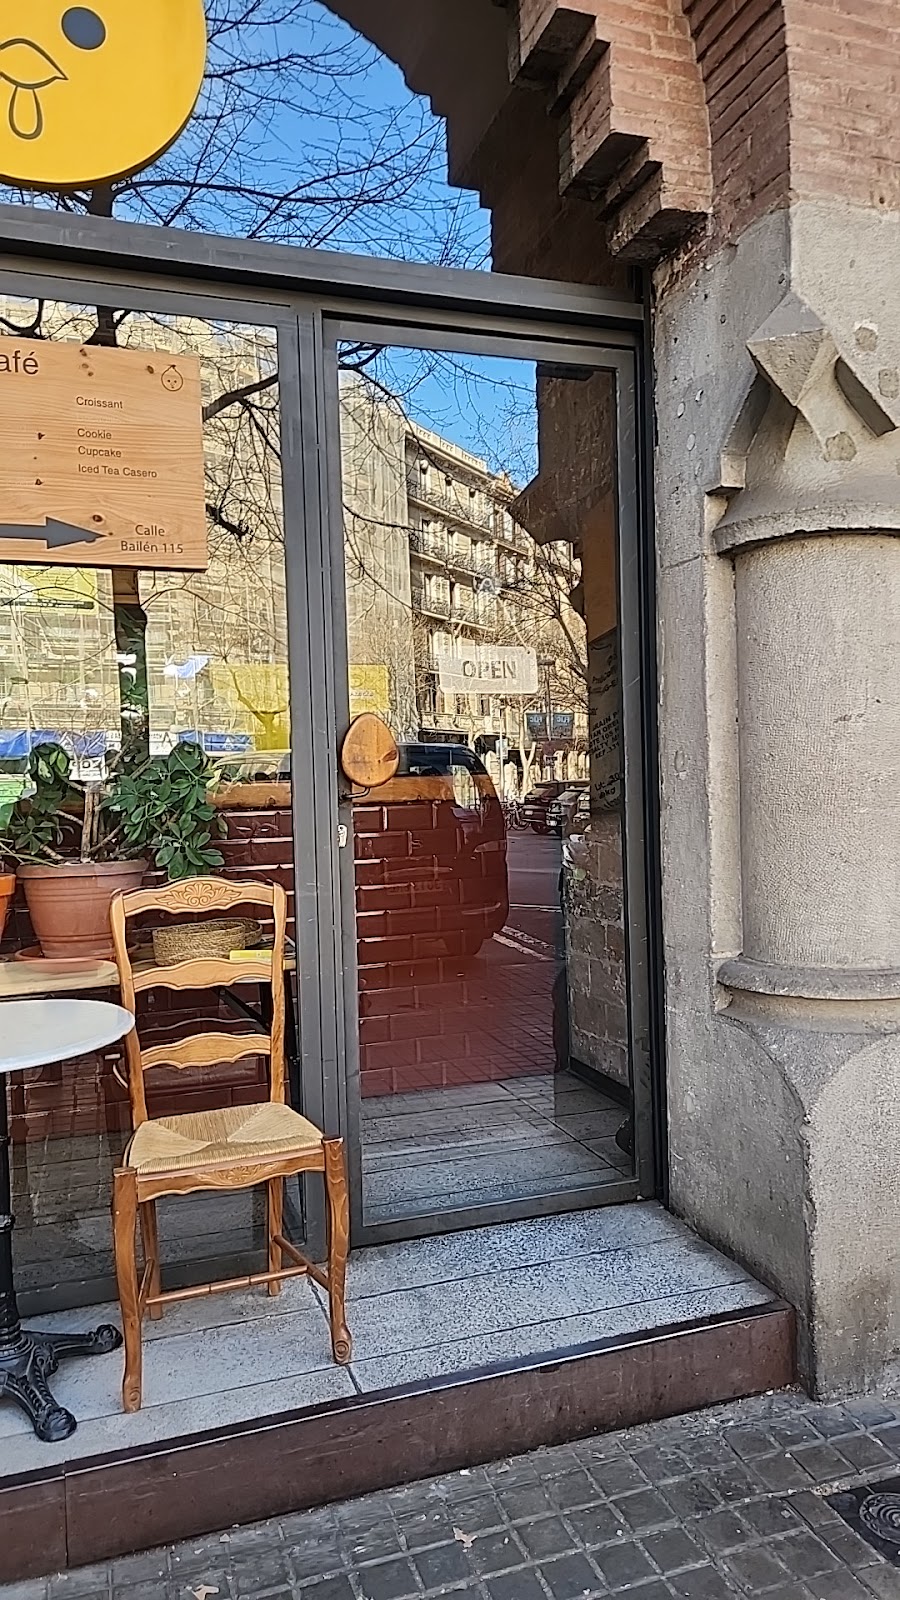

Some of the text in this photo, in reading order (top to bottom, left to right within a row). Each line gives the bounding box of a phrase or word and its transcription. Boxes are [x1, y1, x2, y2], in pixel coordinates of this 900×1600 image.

[76, 396, 123, 409] Croissant
[77, 428, 112, 440] Cookie
[78, 446, 122, 459] Cupcake
[78, 464, 157, 478] Iced Tea Casero
[135, 524, 165, 537] Calle
[121, 540, 184, 554] Bailén 115
[462, 660, 517, 679] OPEN
